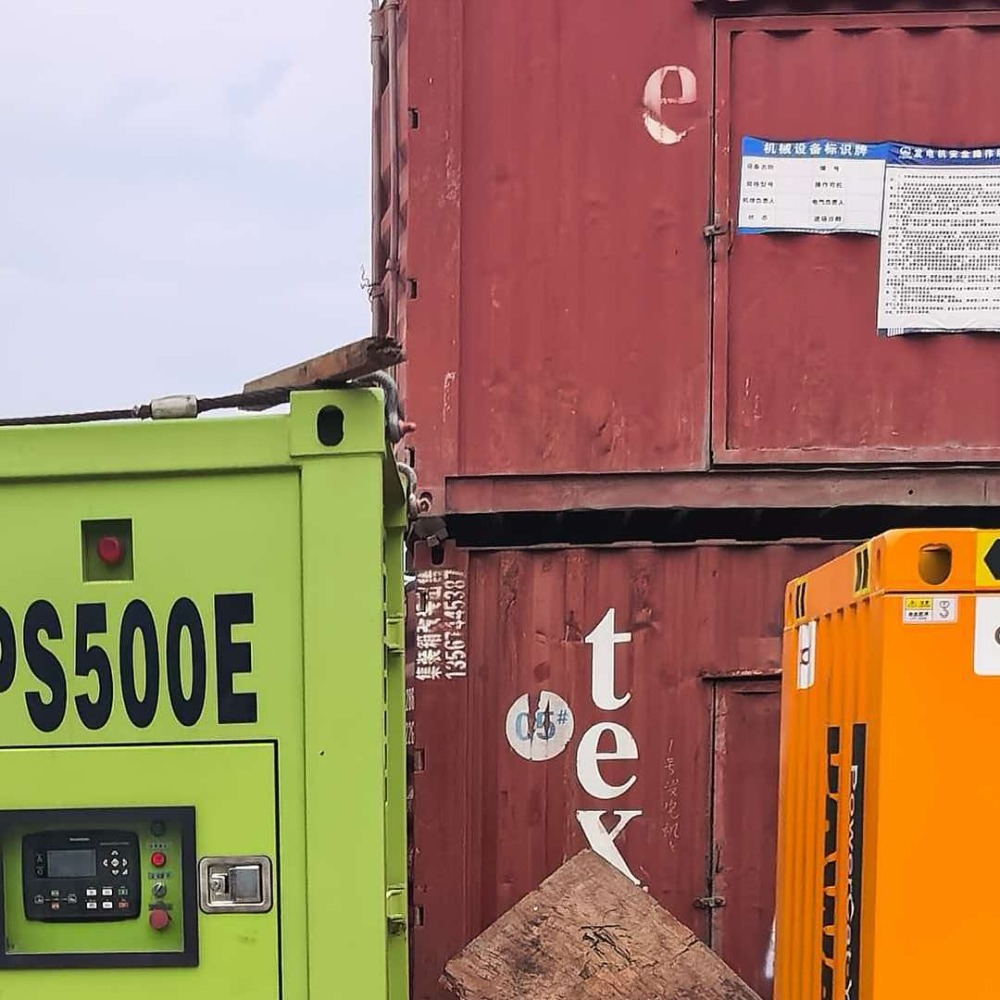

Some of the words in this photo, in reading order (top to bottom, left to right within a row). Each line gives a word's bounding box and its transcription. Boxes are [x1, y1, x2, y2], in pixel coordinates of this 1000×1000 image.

[763, 142, 868, 157] 机械设备标识牌
